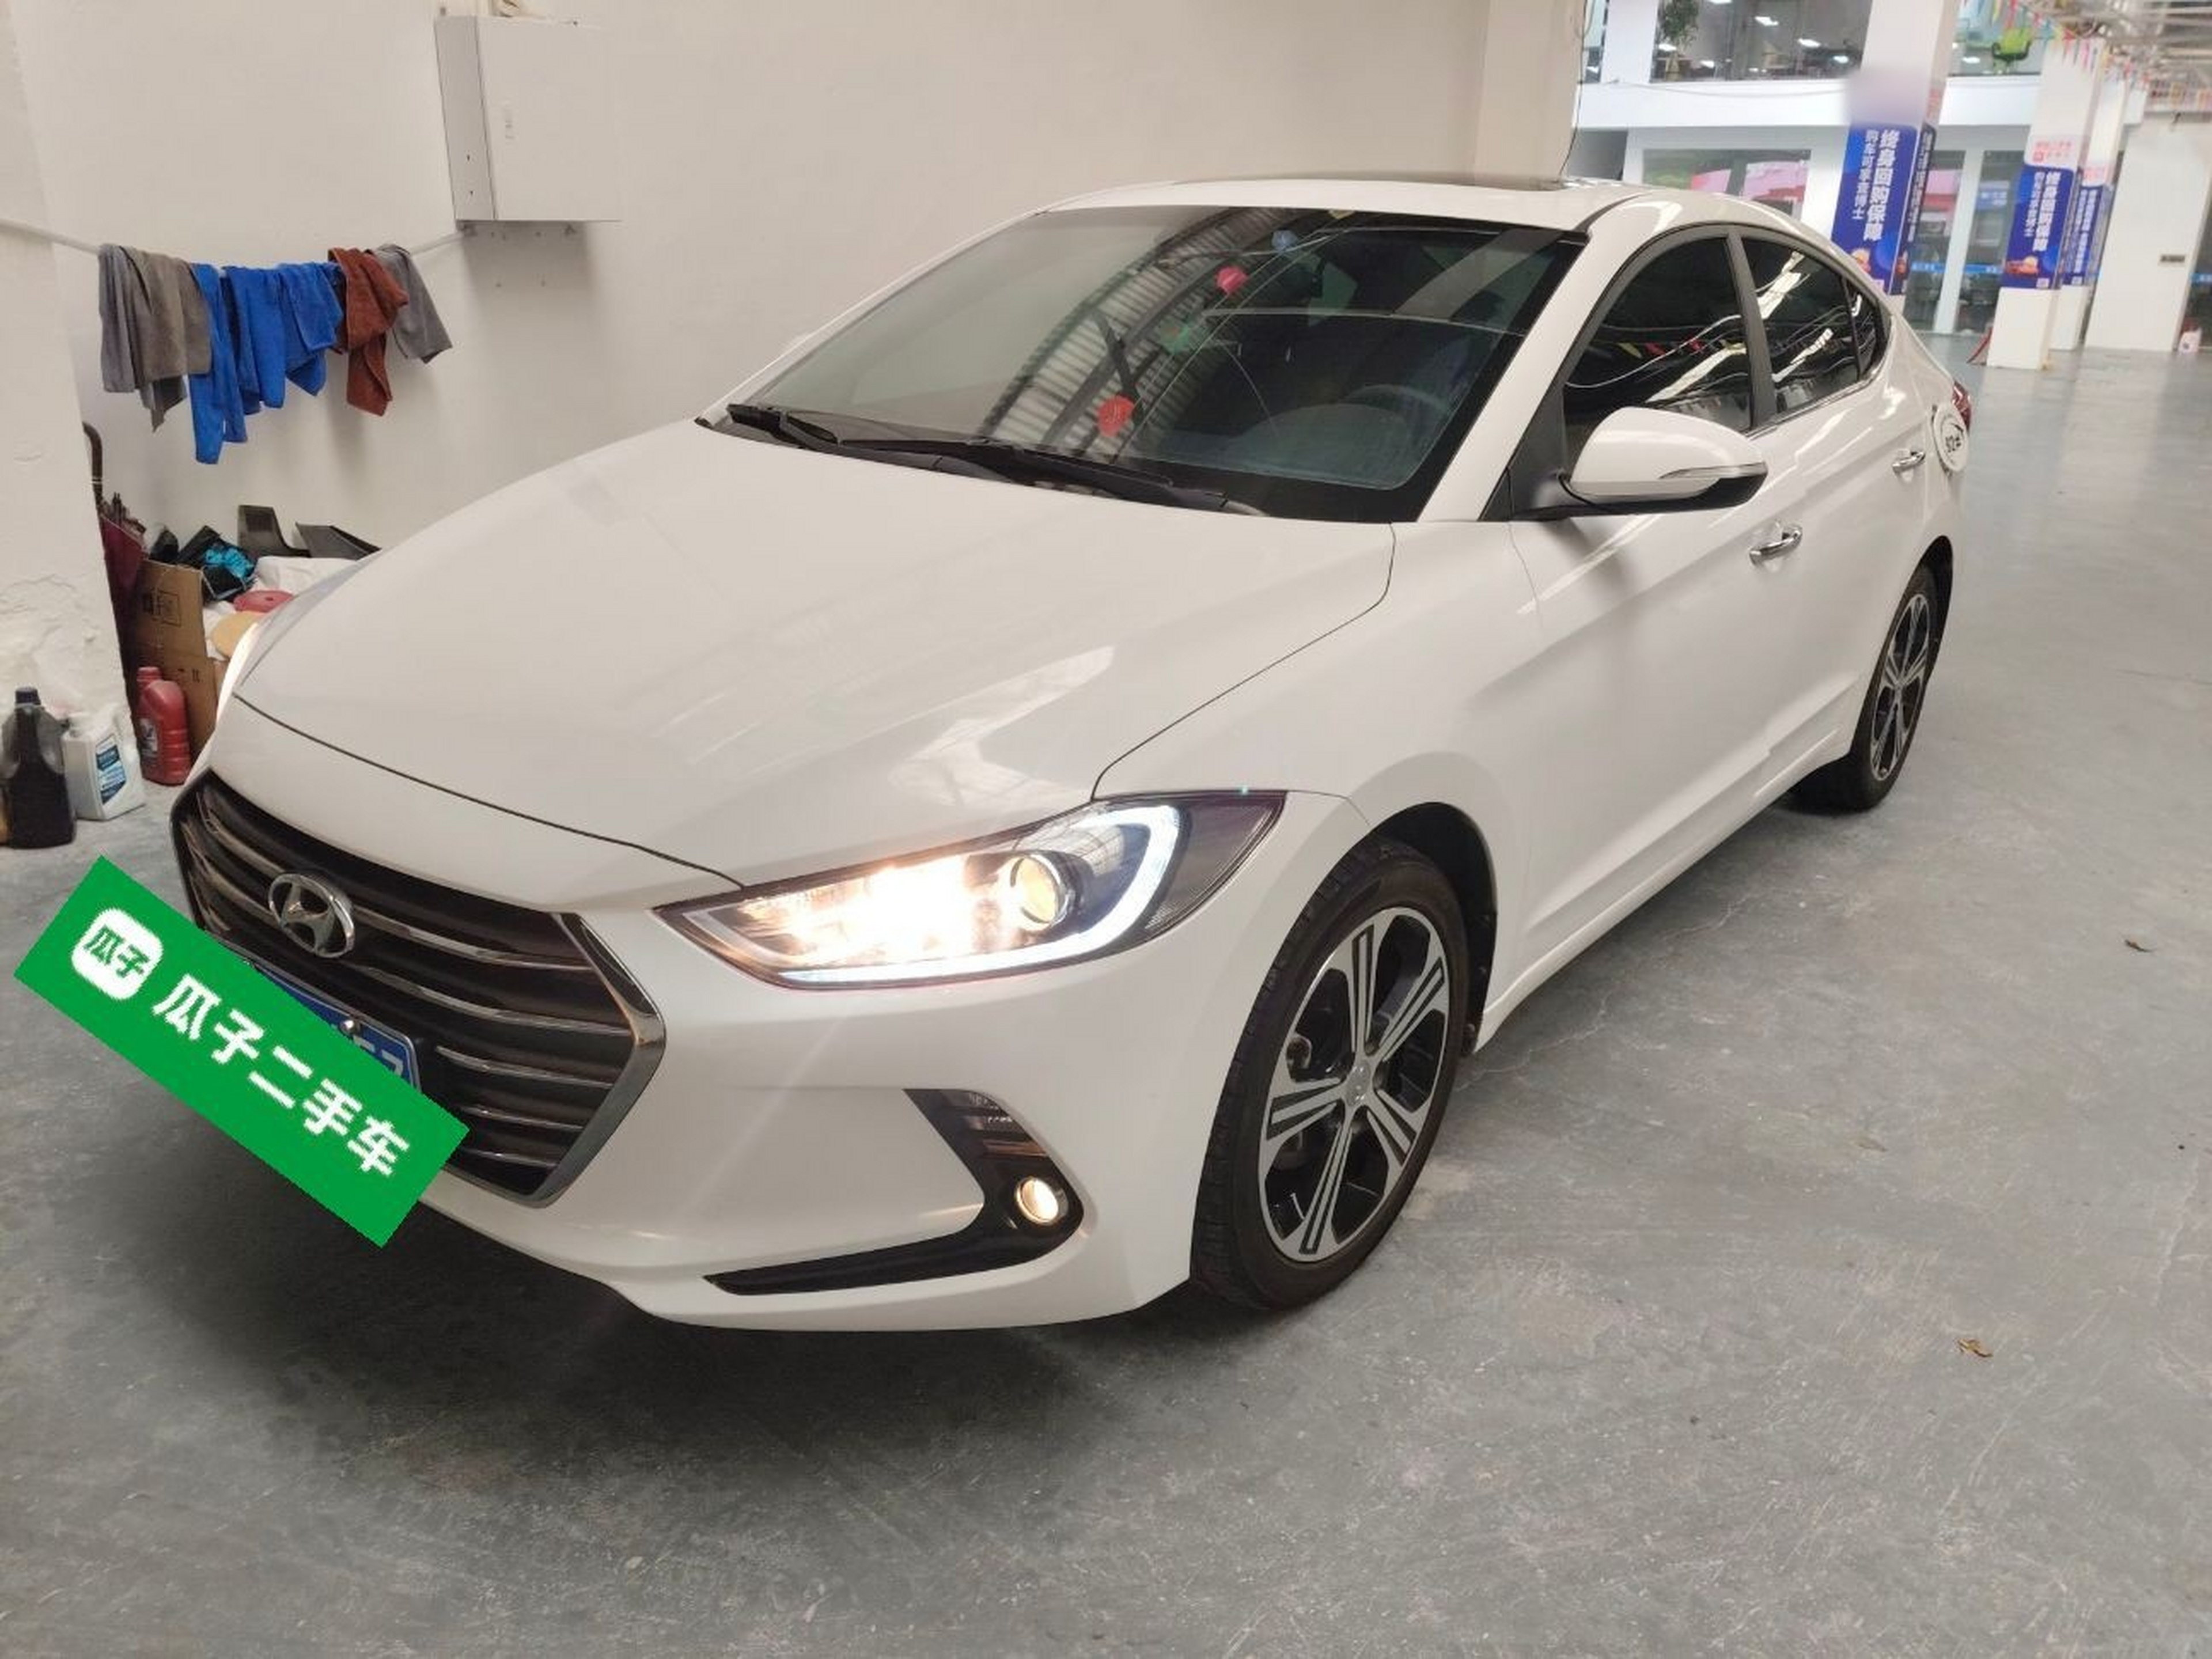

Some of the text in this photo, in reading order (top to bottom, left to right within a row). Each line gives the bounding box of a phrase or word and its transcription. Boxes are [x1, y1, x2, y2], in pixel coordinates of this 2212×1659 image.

[1862, 129, 1900, 241] 终身回购保障
